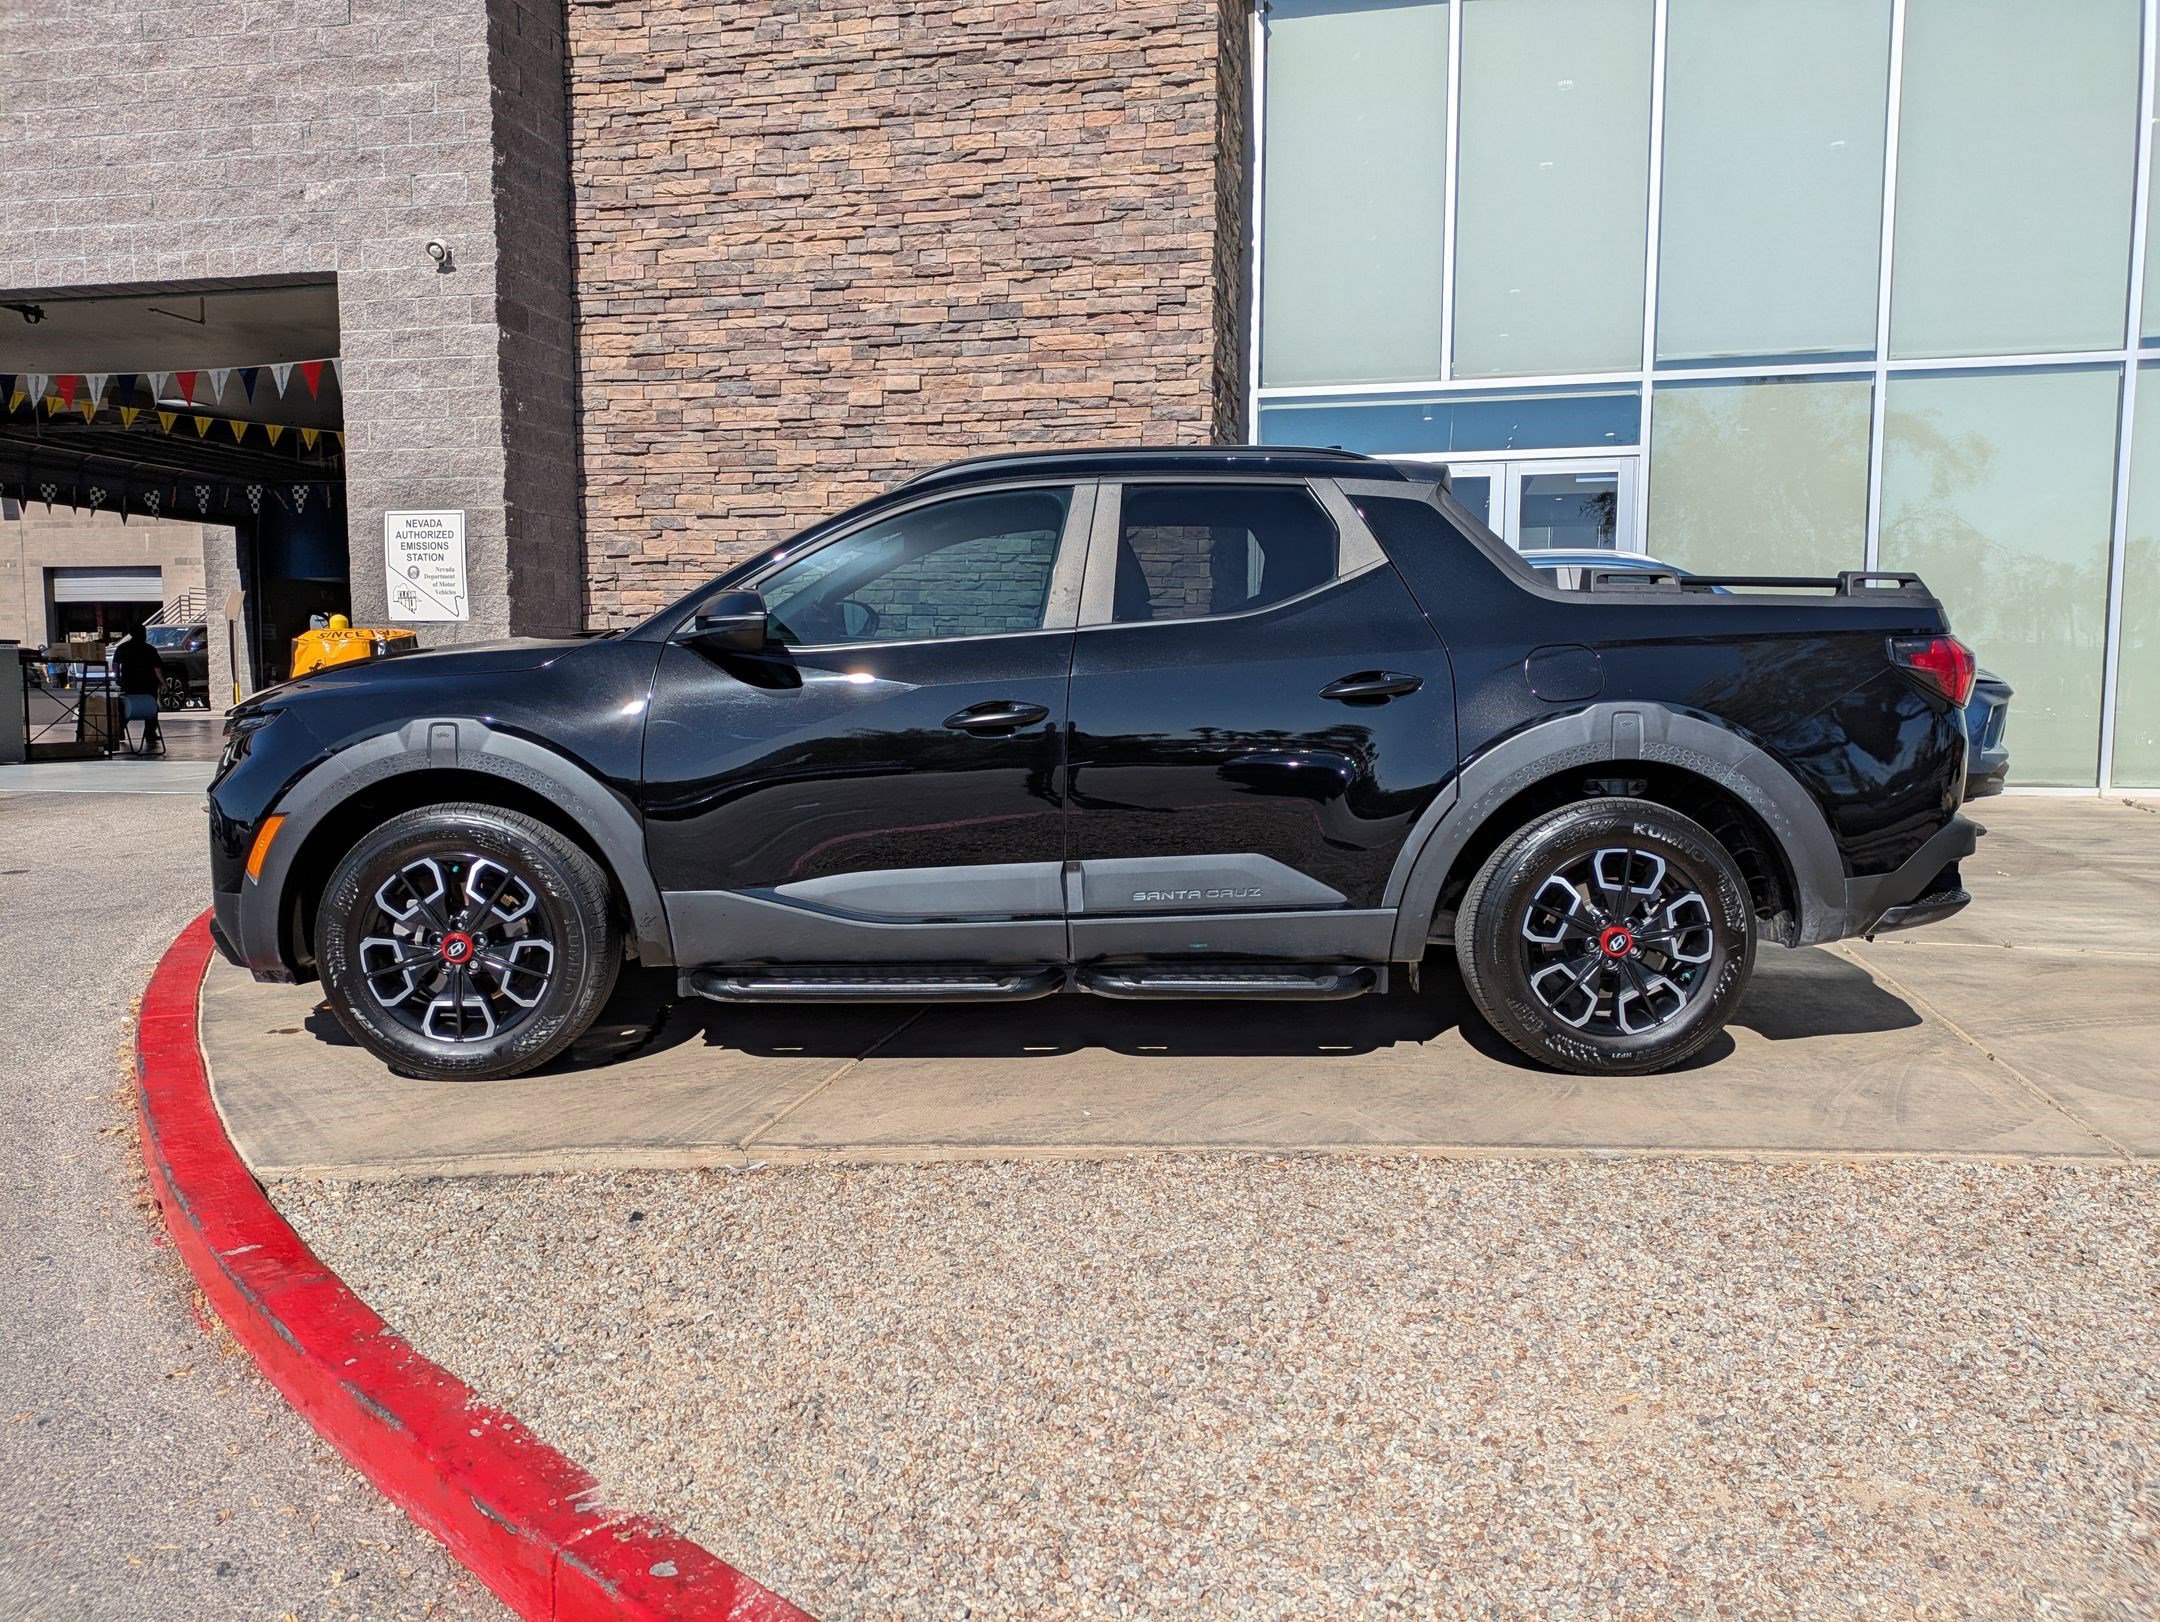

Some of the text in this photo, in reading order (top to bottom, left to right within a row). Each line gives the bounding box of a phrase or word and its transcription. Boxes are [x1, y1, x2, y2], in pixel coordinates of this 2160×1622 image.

[405, 519, 443, 528] NEVADA
[395, 530, 455, 539] AUTHORIZED
[400, 541, 449, 551] EMISSIONS
[406, 552, 445, 562] STATION
[424, 573, 456, 581] Department
[316, 630, 365, 640] SINCE
[1632, 822, 1707, 863] KUMHO
[1132, 887, 1263, 902] SANTA CRUZ
[563, 918, 581, 997] KUMHO
